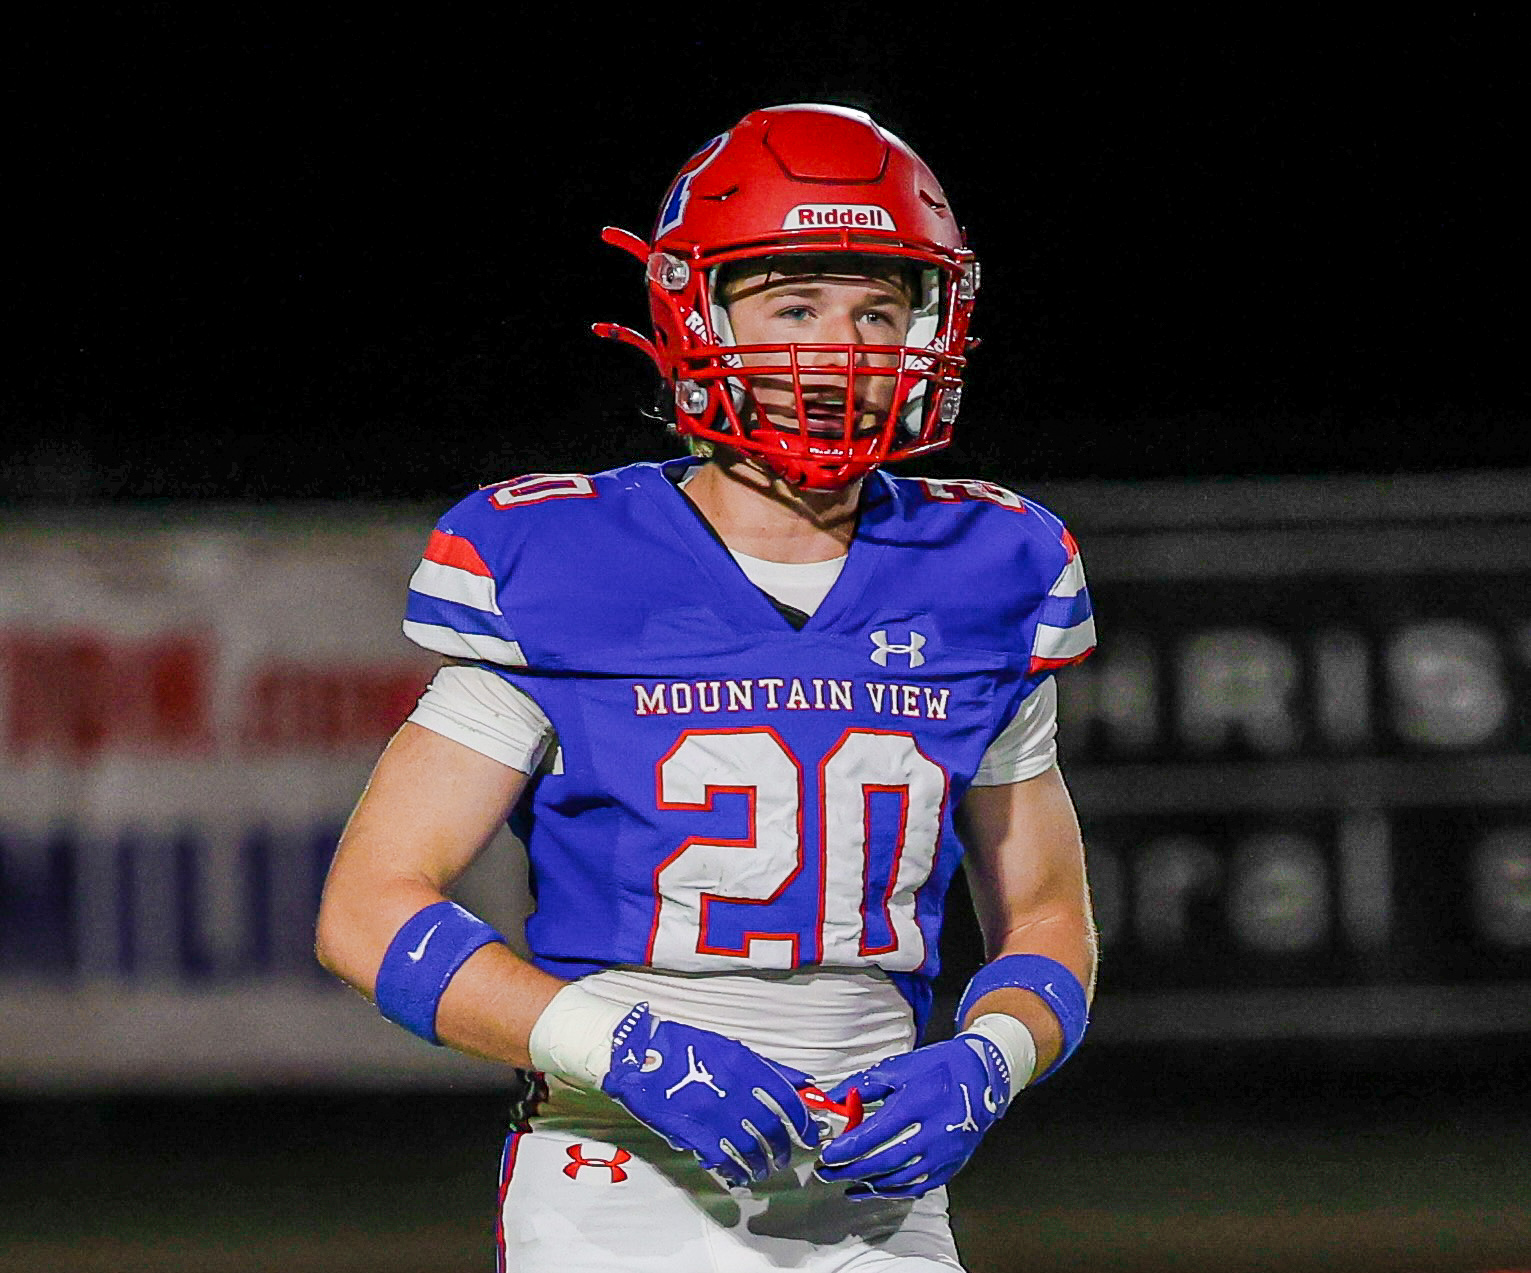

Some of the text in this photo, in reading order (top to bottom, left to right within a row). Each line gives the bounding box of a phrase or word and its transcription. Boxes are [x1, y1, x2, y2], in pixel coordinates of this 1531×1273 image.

[797, 208, 883, 227] Riddell
[633, 677, 950, 720] MOUNTAIN VIEW
[644, 725, 948, 974] 20
